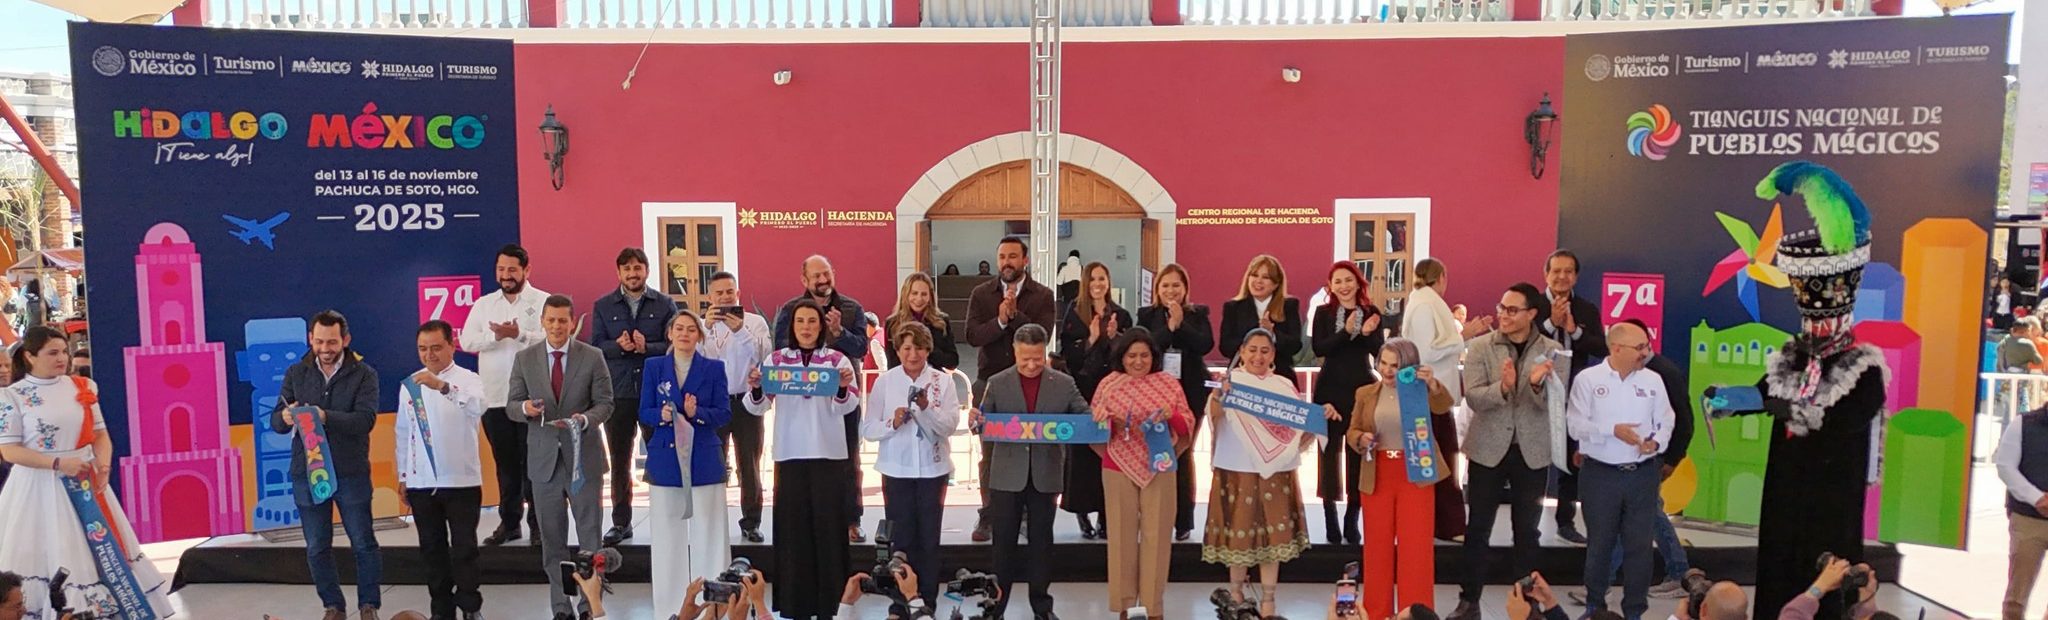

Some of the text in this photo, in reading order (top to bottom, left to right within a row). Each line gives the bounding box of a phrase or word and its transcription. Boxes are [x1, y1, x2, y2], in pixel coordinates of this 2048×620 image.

[129, 50, 195, 60] Gobierno de
[1850, 50, 1910, 60] HIDALGO
[1926, 46, 1990, 57] TURISMO
[213, 56, 275, 70] Turismo
[1614, 54, 1669, 64] Gobierno de
[1684, 55, 1741, 68] Turismo
[129, 59, 196, 76] México
[382, 64, 433, 73] HIDALGO
[447, 65, 497, 74] TURISMO
[1613, 62, 1669, 78] México
[315, 169, 478, 180] del 13 al 16 de noviembre
[315, 185, 479, 196] PACHUCA DE SOTO, HGO.
[354, 204, 445, 231] 2025
[760, 212, 817, 221] HIDALGO
[828, 211, 894, 221] HACIENDA
